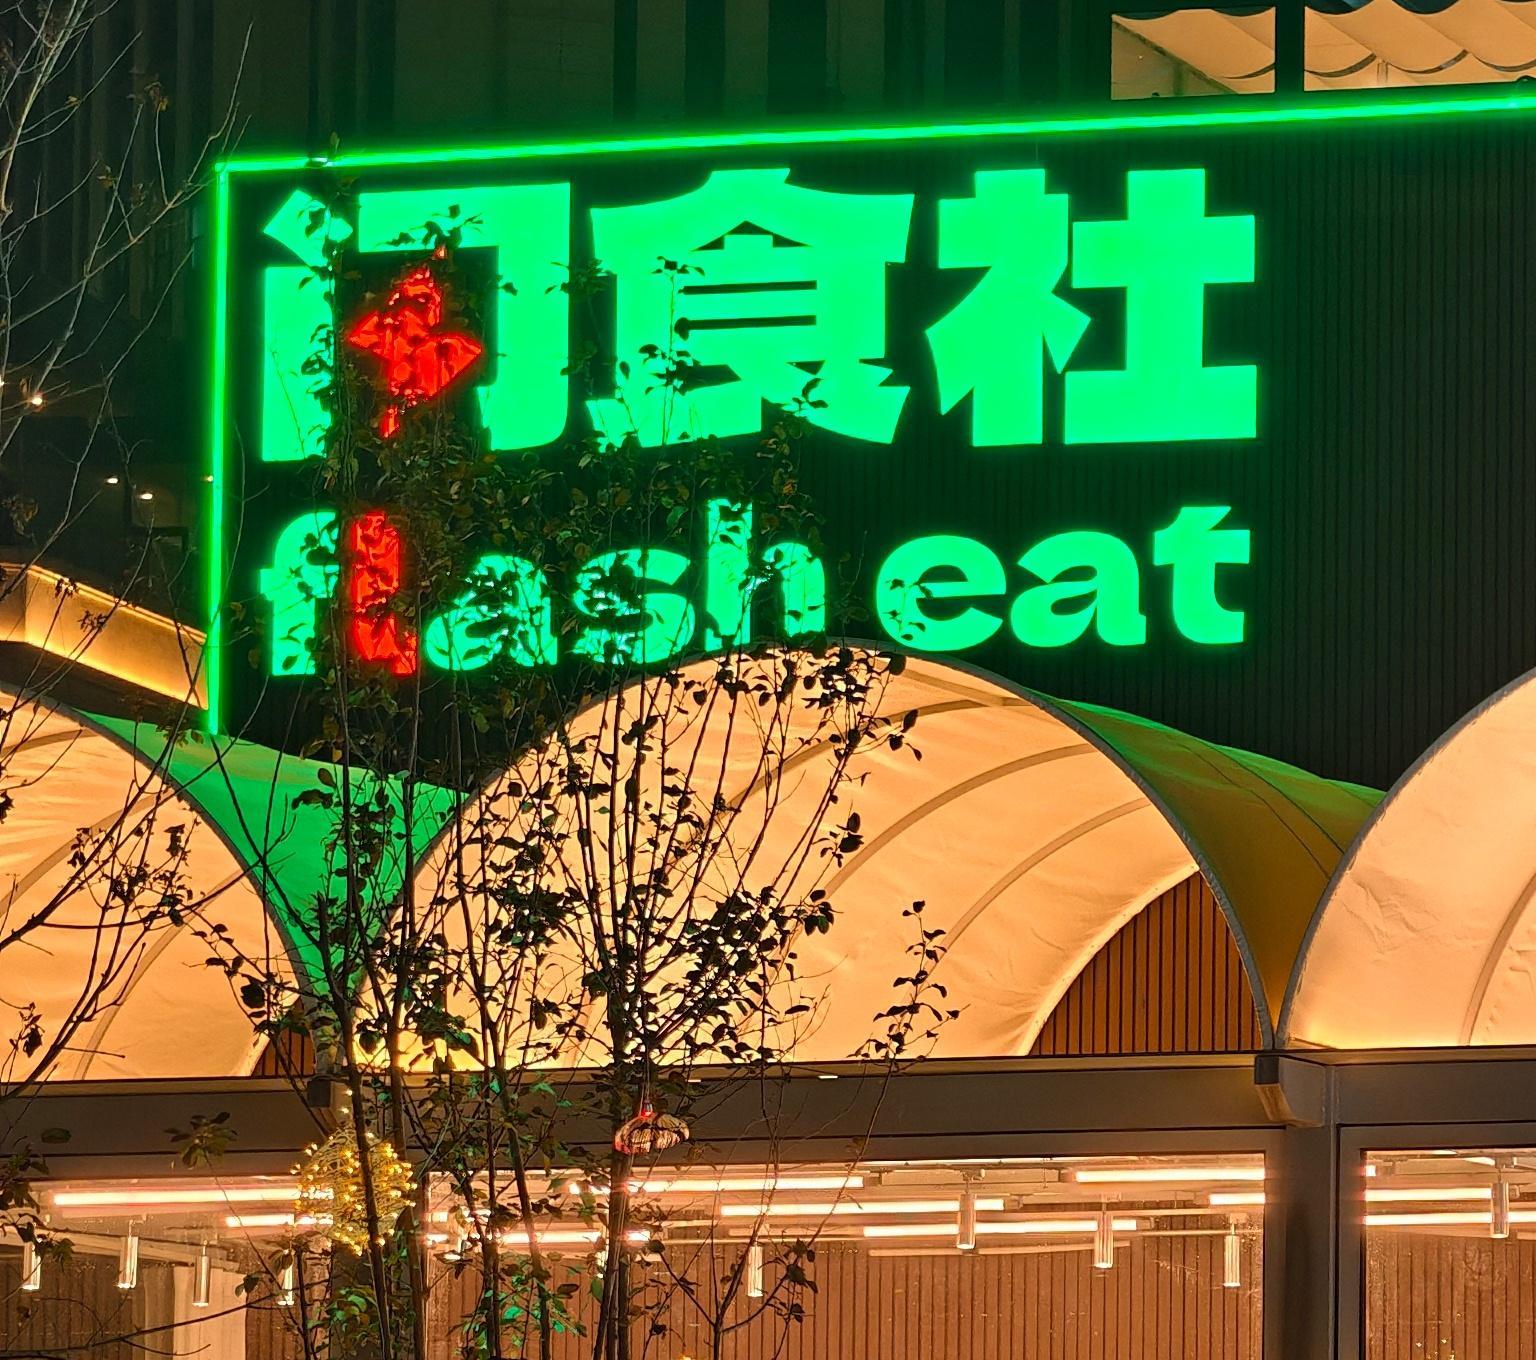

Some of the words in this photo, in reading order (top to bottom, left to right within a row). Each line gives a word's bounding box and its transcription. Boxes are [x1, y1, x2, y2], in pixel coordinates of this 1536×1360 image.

[260, 168, 1258, 462] 闪食社
[258, 498, 826, 677] flash
[874, 505, 1252, 648] eat
